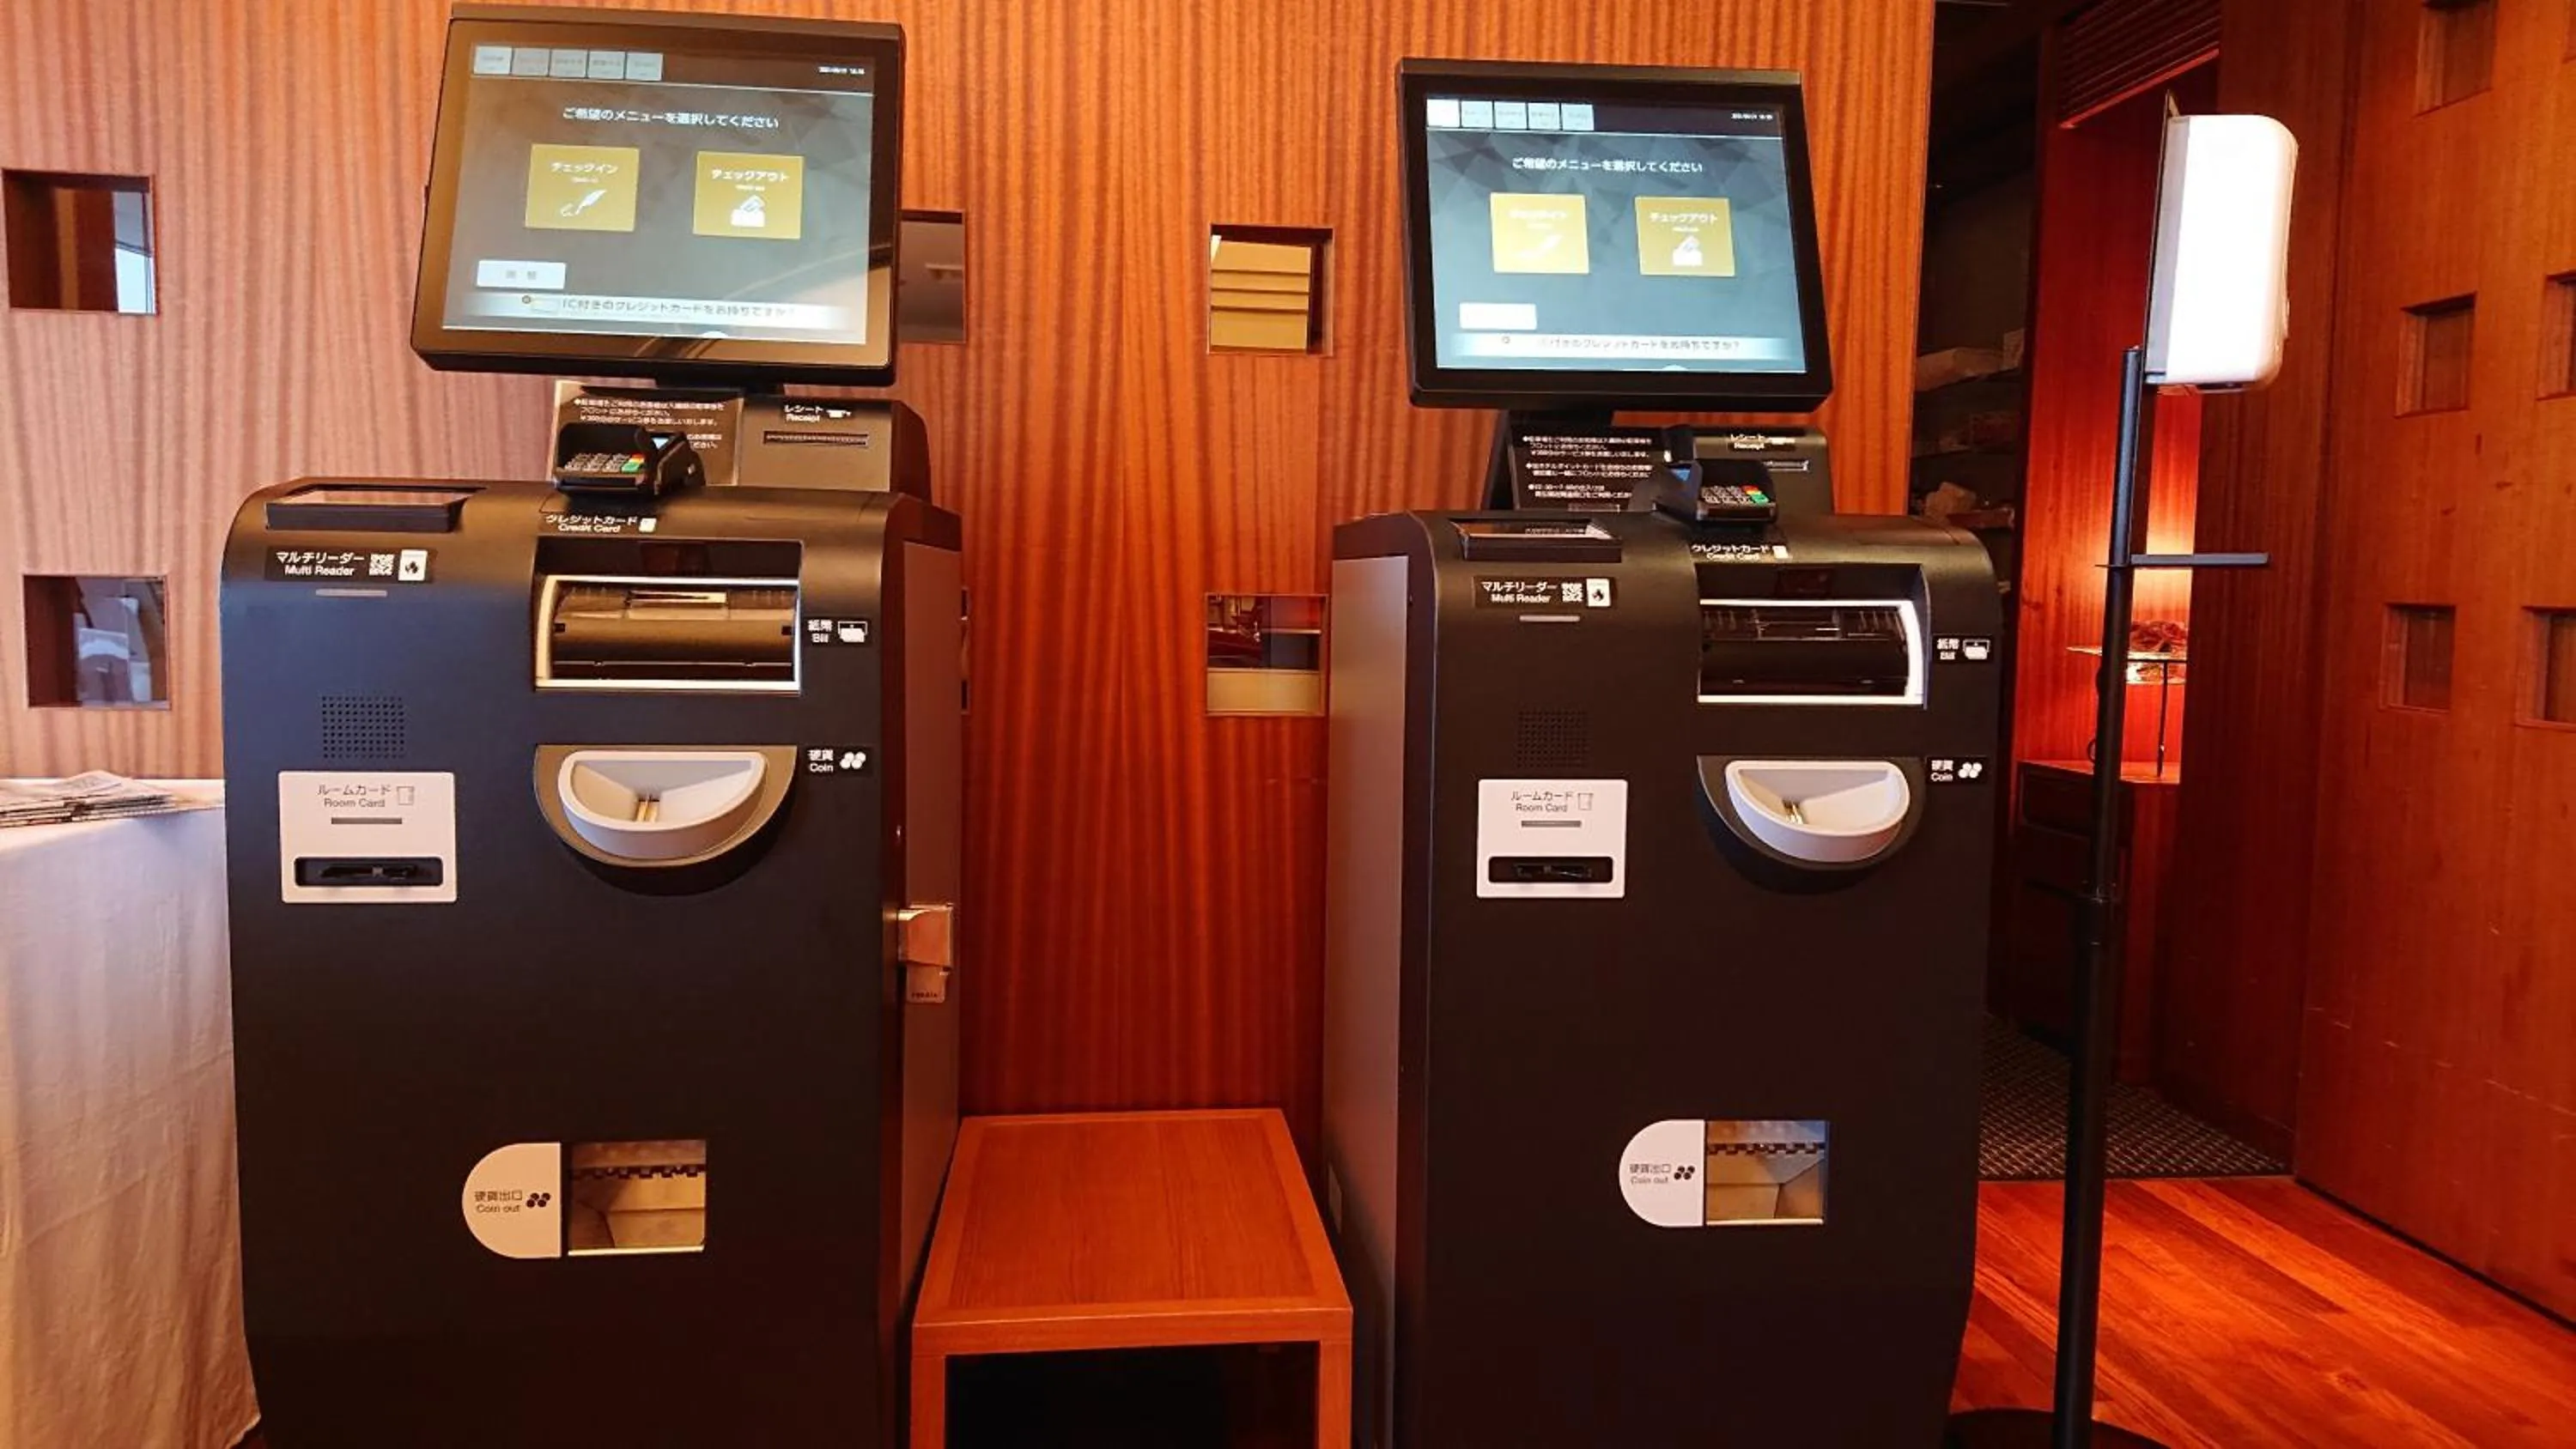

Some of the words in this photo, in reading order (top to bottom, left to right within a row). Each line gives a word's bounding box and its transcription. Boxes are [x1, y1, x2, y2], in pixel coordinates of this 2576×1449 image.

[562, 107, 780, 128] ご希望のメニューを選択してください
[1512, 157, 1703, 173] ご希望のメニューを選択してください
[712, 170, 789, 181] チェックアウト
[784, 404, 823, 415] レシート
[786, 413, 820, 422] Receipt
[1730, 433, 1766, 442] レシート
[1734, 442, 1765, 451] Receipt
[545, 514, 638, 526] クレジットカード
[557, 523, 592, 532] Credit
[593, 524, 621, 533] Card
[1691, 543, 1771, 554] クレジットカード
[276, 550, 365, 564] マルチリーダー
[284, 565, 313, 576] Multi
[314, 566, 356, 577] Reader
[1480, 581, 1558, 593] マルチリーダー
[1491, 593, 1516, 603] Multi
[1516, 593, 1552, 603] Reader
[808, 620, 832, 632] 紙幣
[811, 633, 829, 643] Bill
[807, 749, 834, 761] 硬貨
[810, 762, 834, 773] Coin
[1930, 760, 1953, 771] 硬貨
[1930, 772, 1953, 782] Coin
[316, 785, 392, 796] ルームカード
[1511, 791, 1574, 801] ルームカード
[324, 797, 356, 808] Room
[358, 797, 386, 808] Card
[1516, 803, 1543, 812] Room
[1545, 803, 1568, 813] Card
[1629, 1163, 1672, 1173] 硬貨出口
[1631, 1175, 1651, 1185] Coin
[474, 1190, 523, 1202] 硬貨出口
[477, 1203, 501, 1213] Coin
[502, 1204, 520, 1213] out
